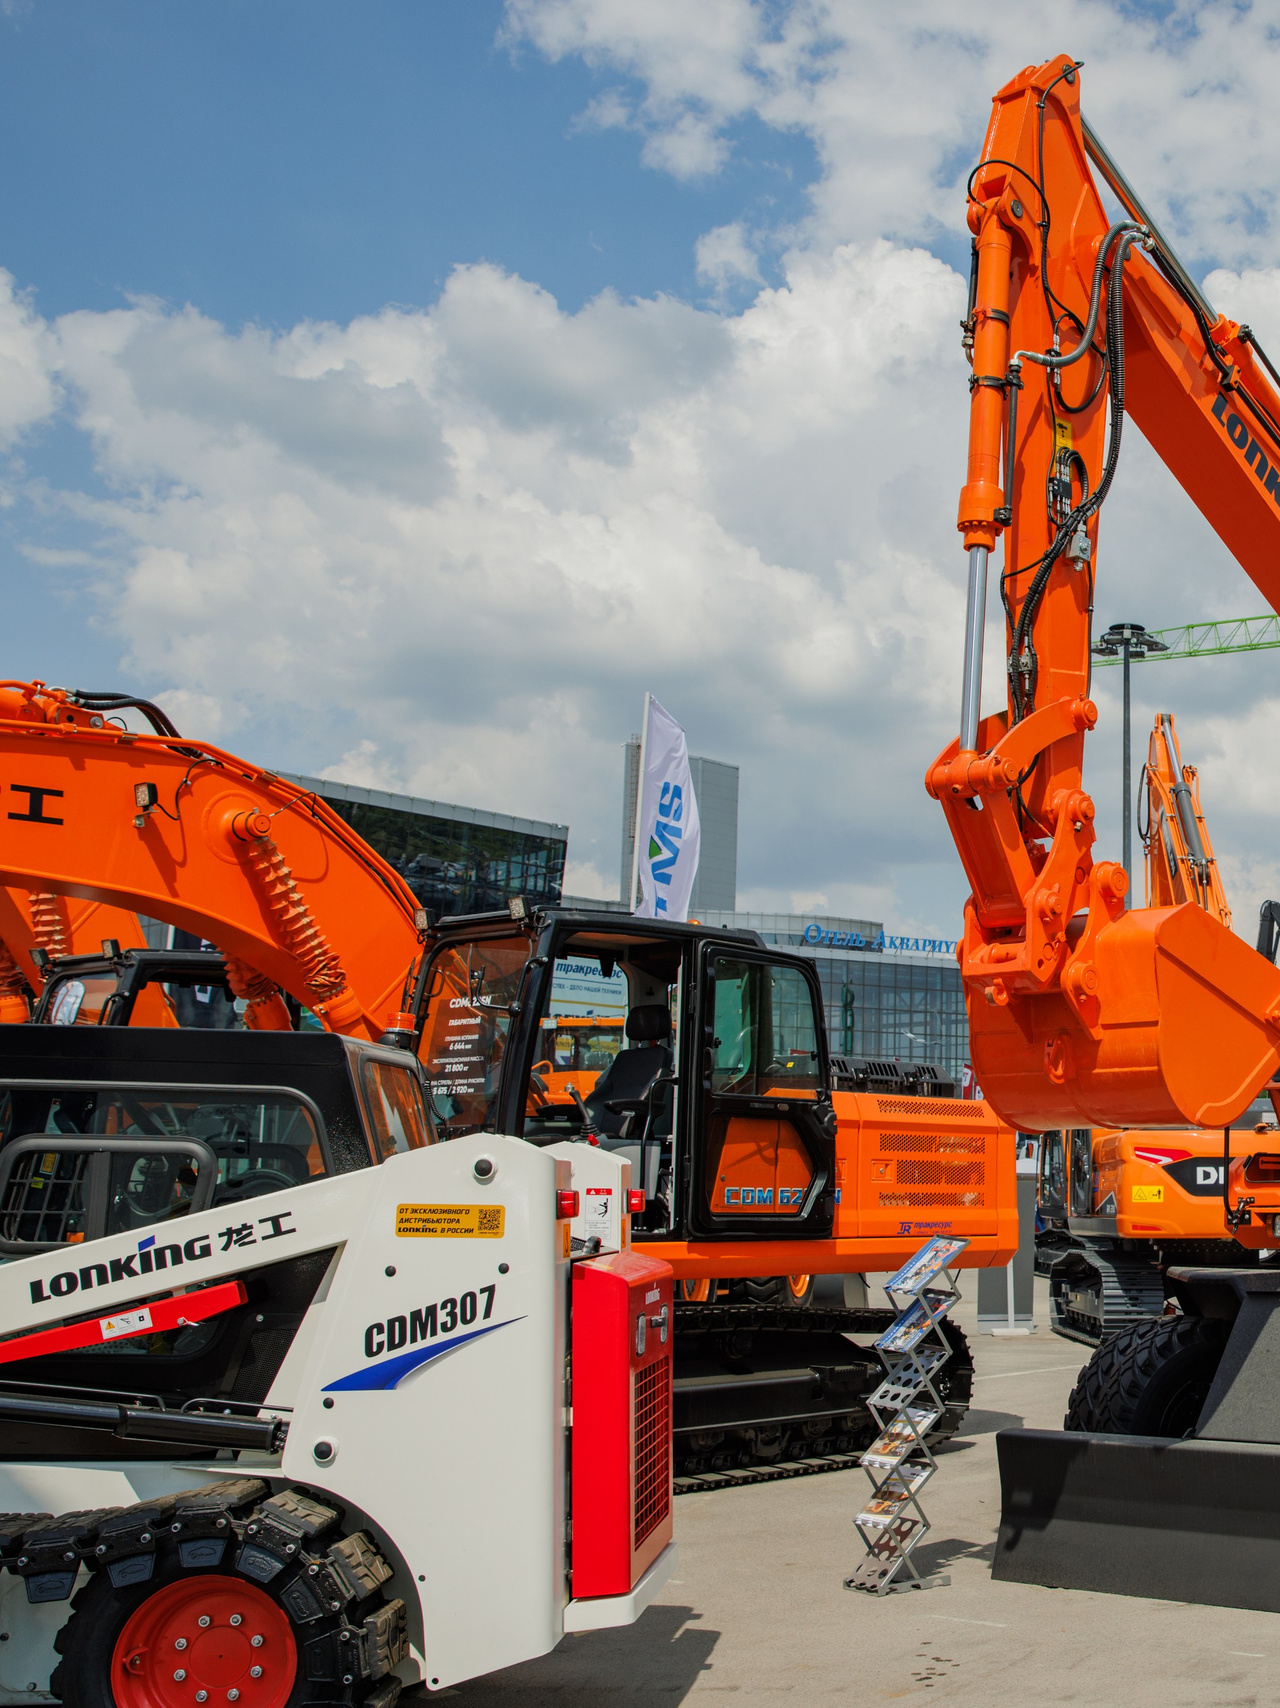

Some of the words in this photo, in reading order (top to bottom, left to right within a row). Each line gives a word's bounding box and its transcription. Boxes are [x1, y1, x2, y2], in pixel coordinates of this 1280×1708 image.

[556, 963, 622, 979] тракресрс
[725, 1187, 773, 1205] CDM
[30, 1235, 212, 1304] LONKING
[365, 1283, 496, 1358] CDM307
